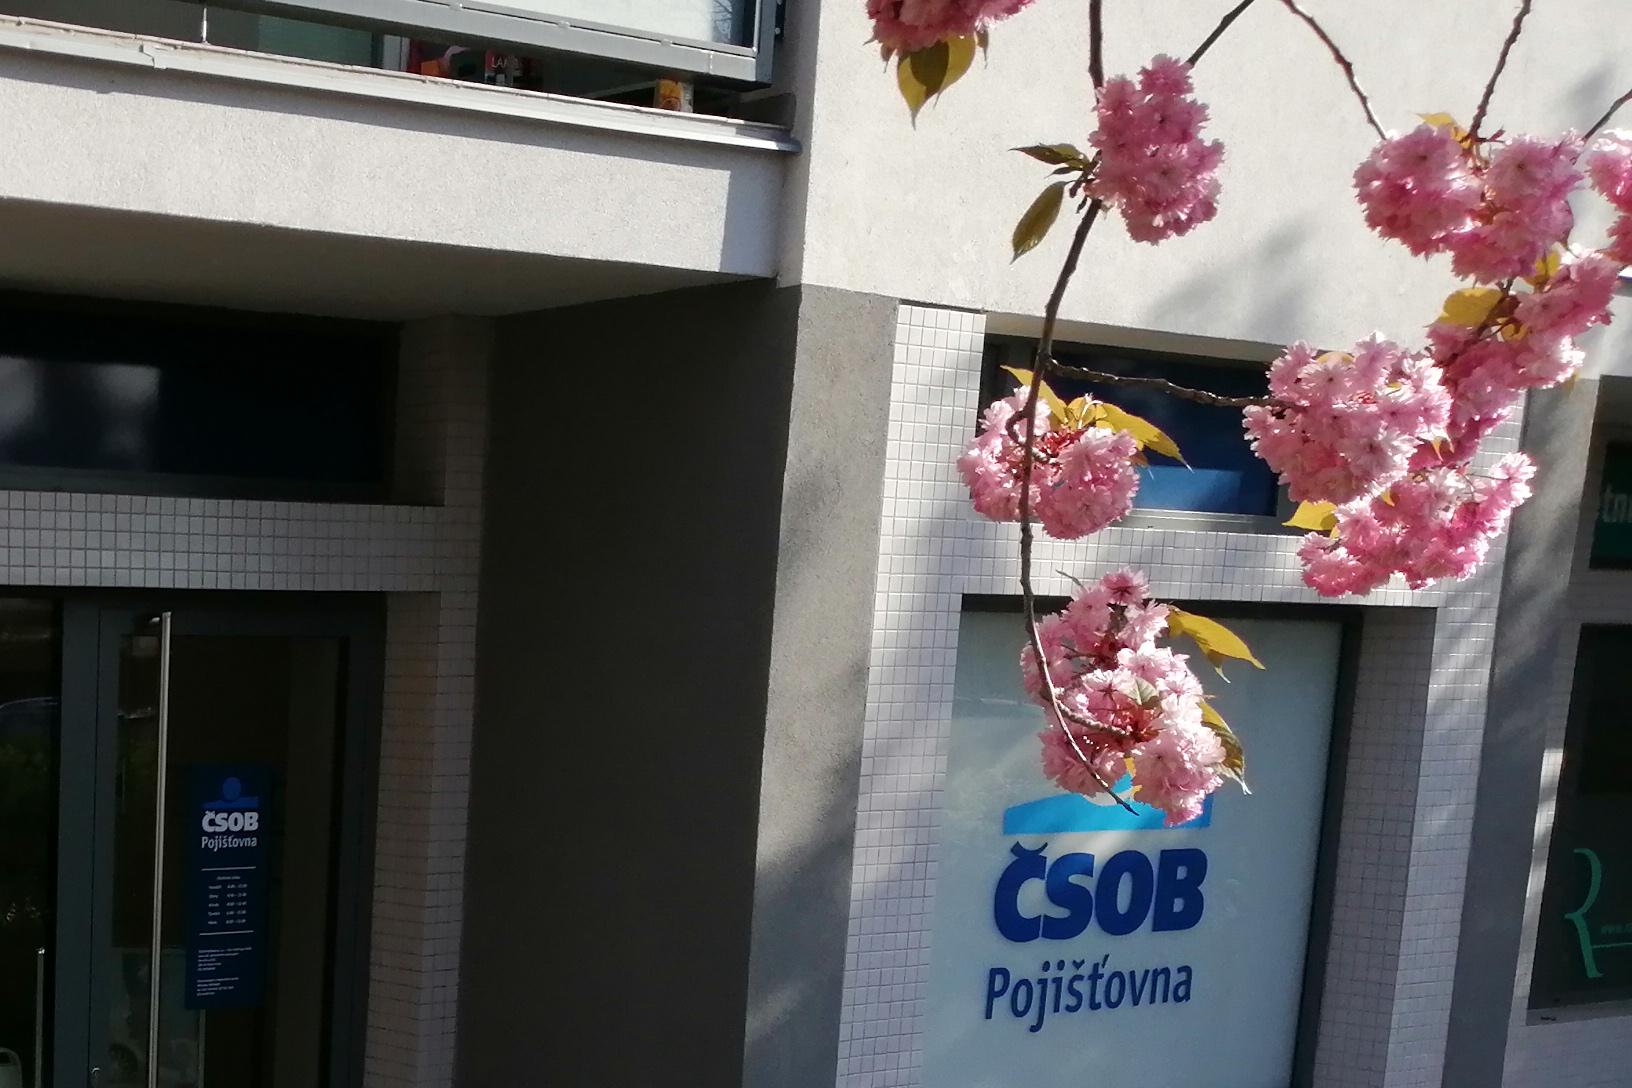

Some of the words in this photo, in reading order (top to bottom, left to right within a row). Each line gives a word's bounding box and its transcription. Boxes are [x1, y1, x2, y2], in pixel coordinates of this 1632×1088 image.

[201, 835, 258, 852] Pojišťovna
[202, 810, 259, 832] ČSOB
[994, 841, 1209, 943] ČSOB
[984, 954, 1194, 1033] Pojišťovna
